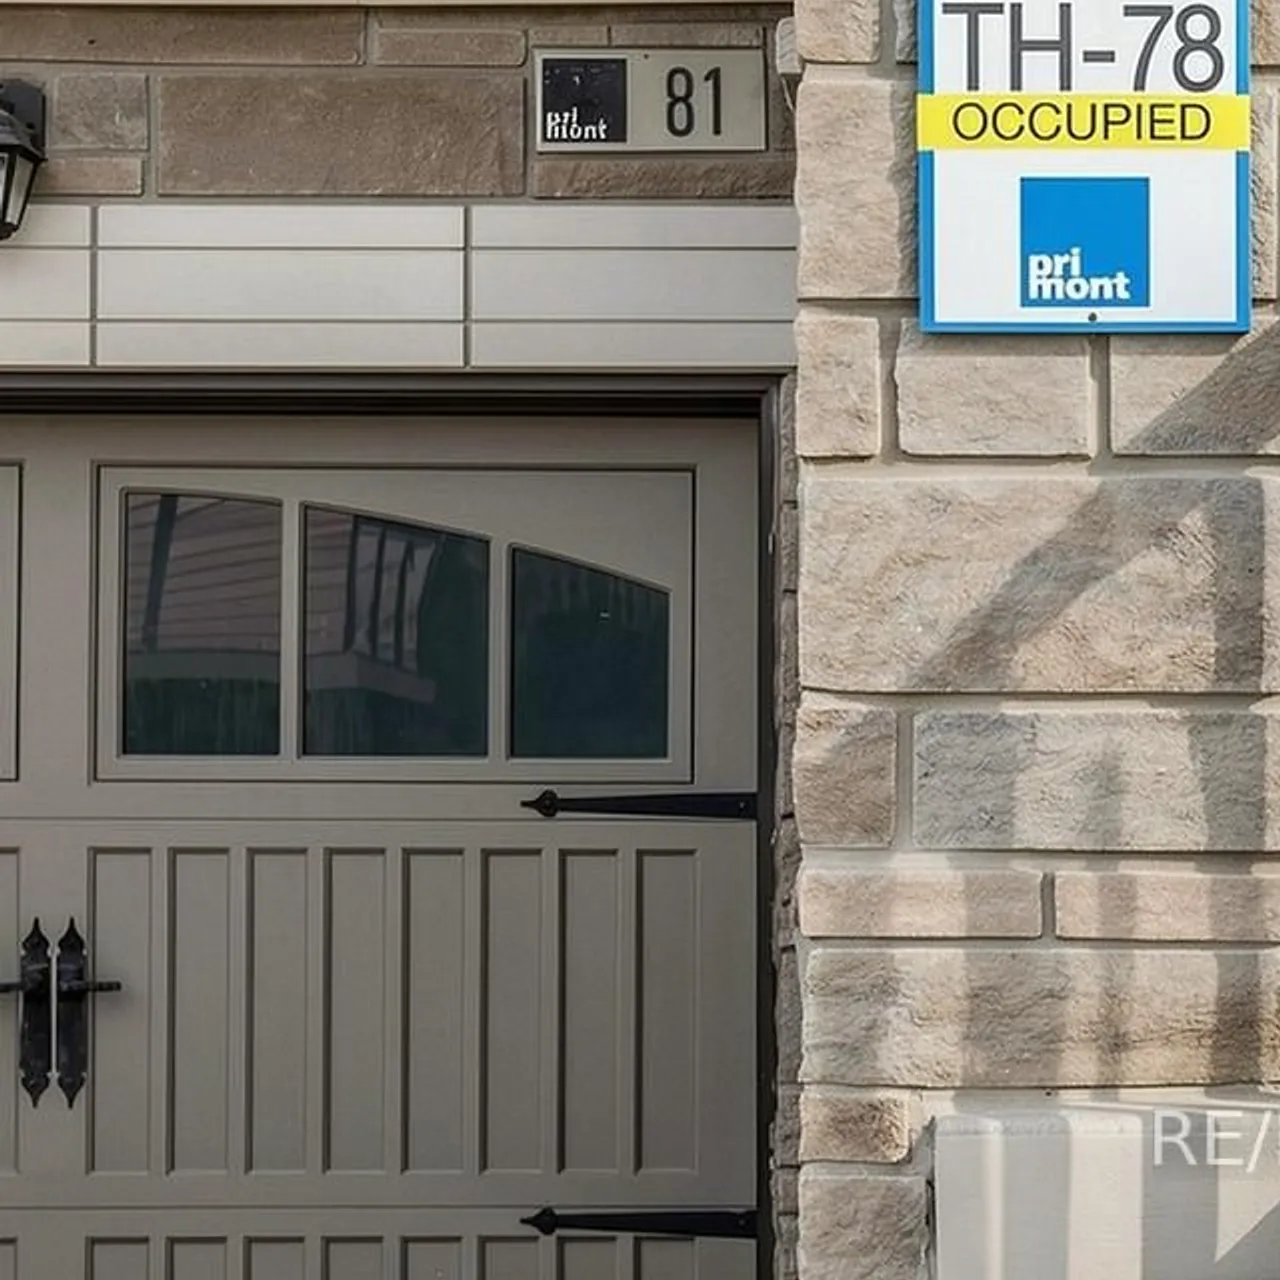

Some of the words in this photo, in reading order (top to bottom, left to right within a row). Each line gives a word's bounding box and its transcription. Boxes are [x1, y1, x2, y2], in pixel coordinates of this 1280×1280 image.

[942, 2, 1225, 92] TH-78
[666, 66, 722, 136] 81
[952, 101, 1212, 141] OCCUPIED
